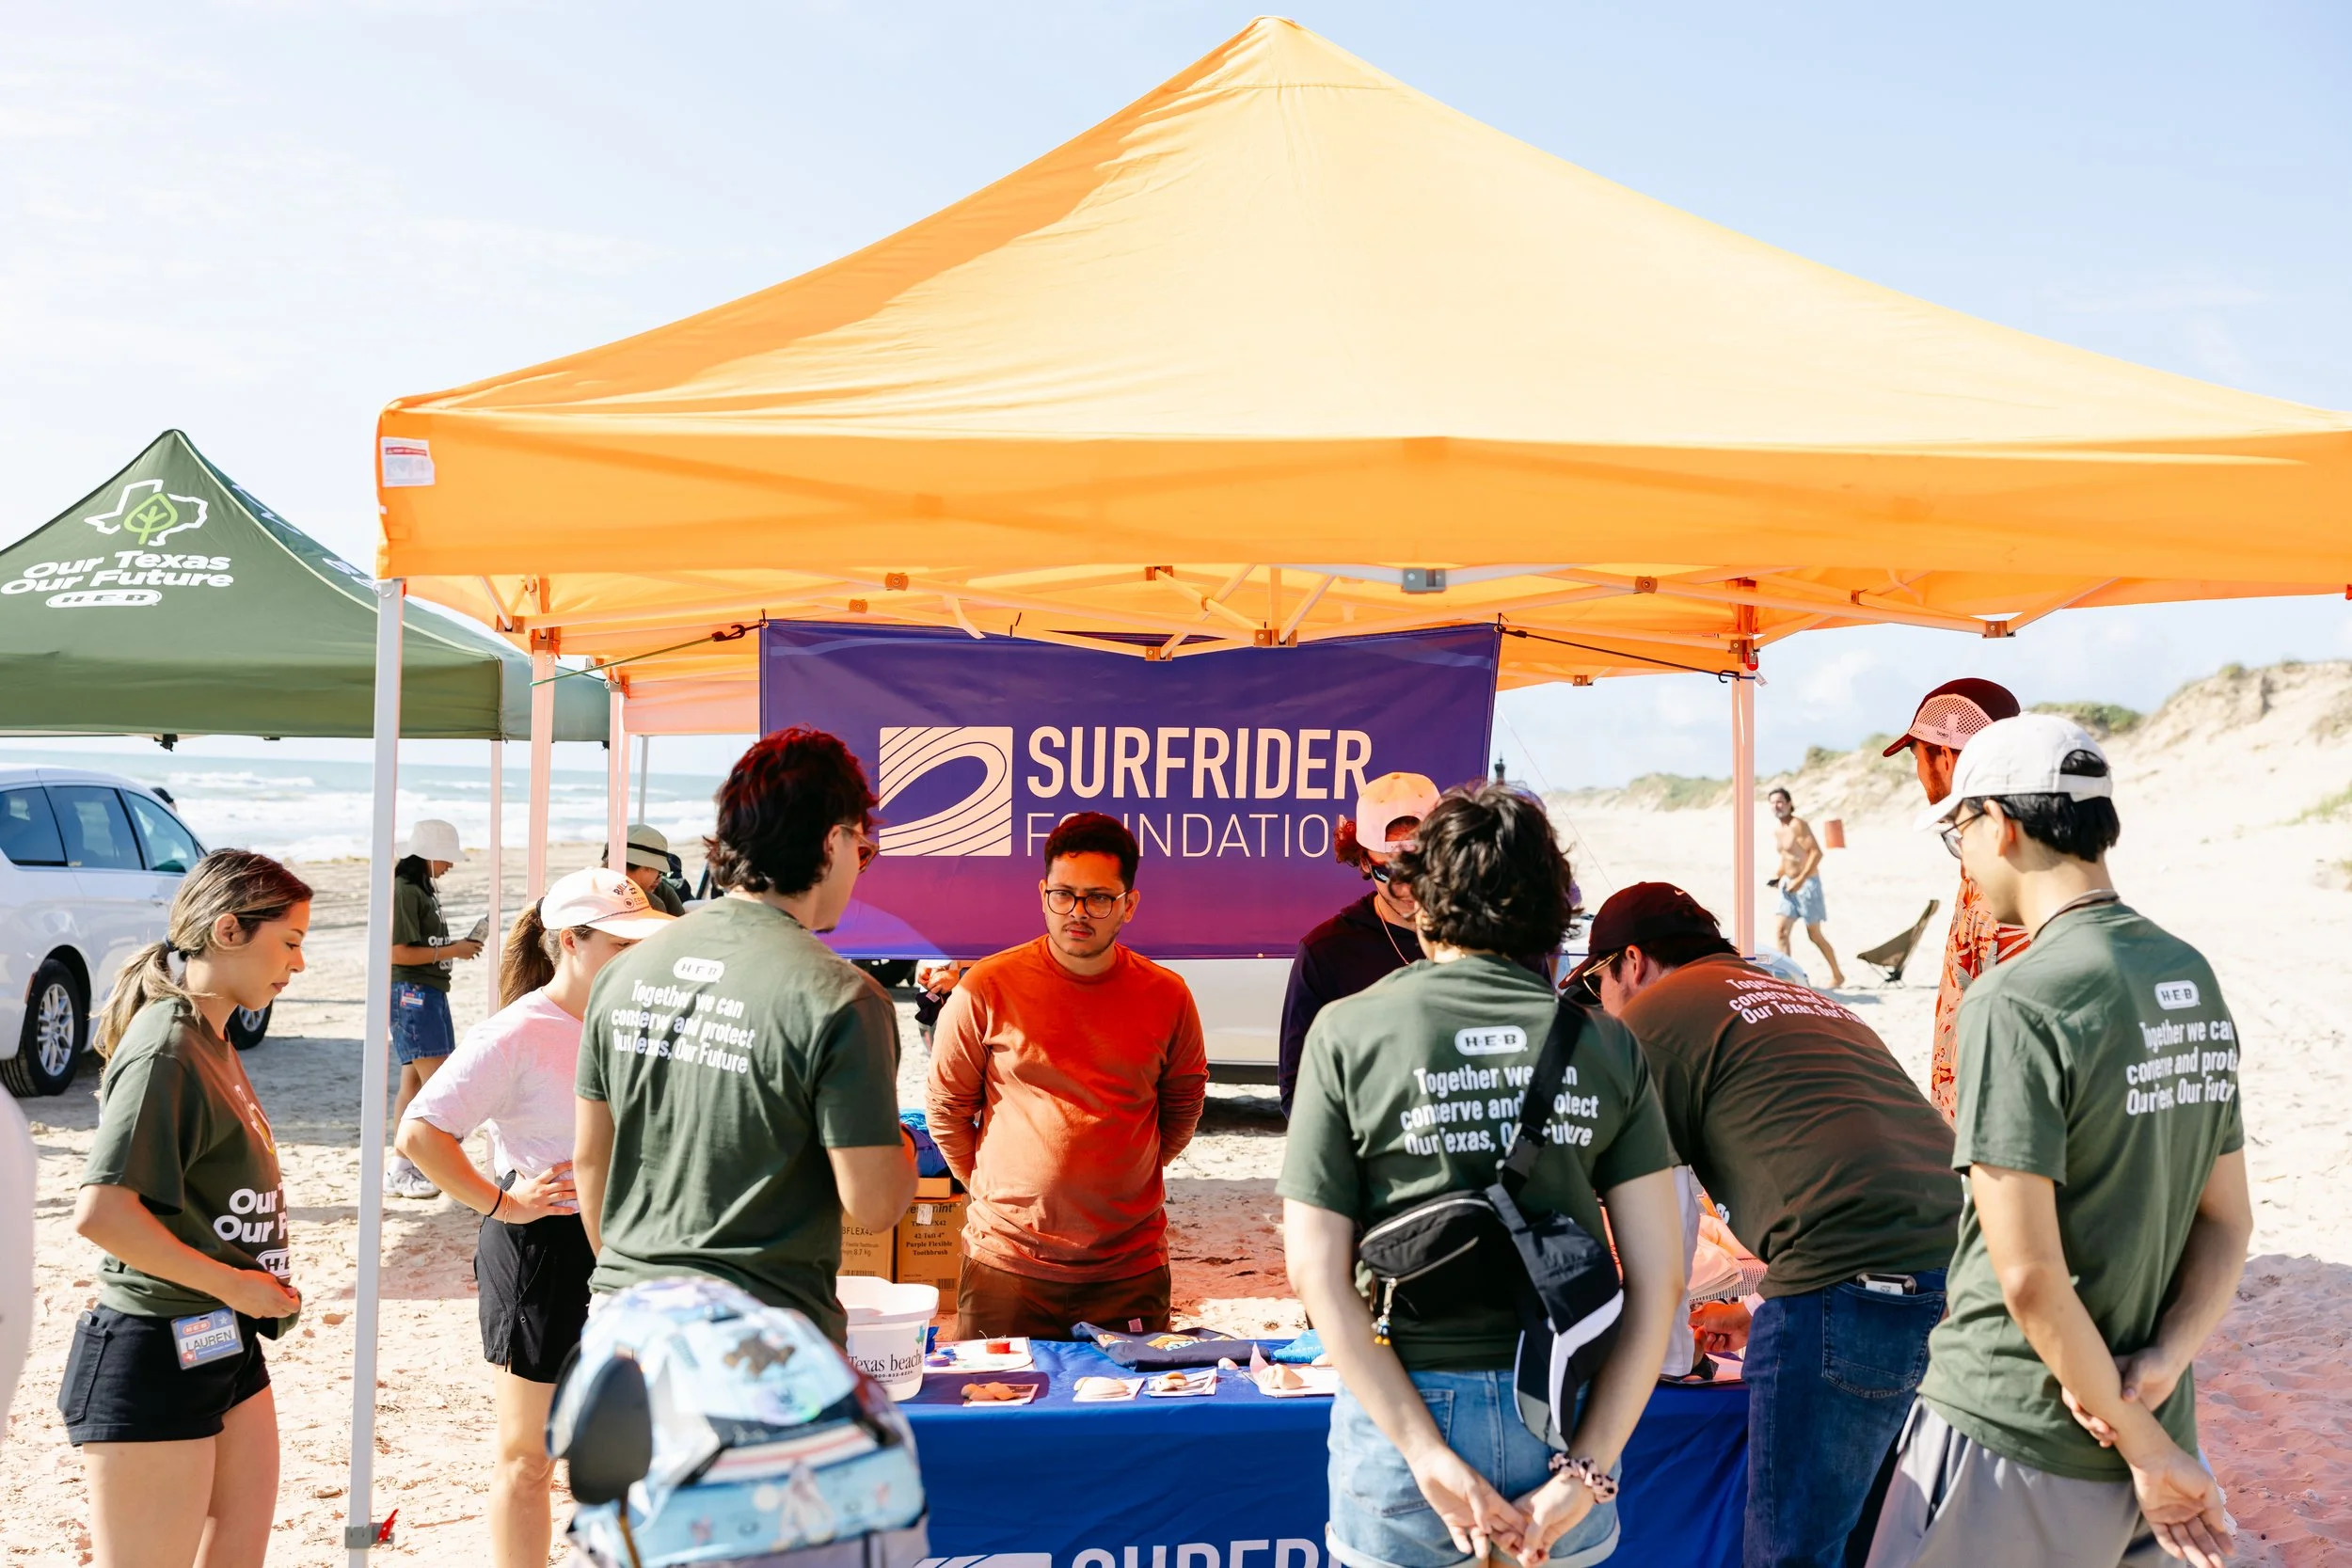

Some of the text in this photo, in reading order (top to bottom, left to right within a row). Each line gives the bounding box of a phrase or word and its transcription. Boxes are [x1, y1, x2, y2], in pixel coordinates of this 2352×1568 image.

[23, 550, 231, 578] Our Texas
[0, 569, 234, 594] Our Future
[1026, 725, 1373, 800] SURFRIDER
[1026, 812, 1347, 858] FNDATIO
[631, 979, 744, 1019] Together we can
[1729, 990, 1797, 1011] conserve
[1740, 1004, 1773, 1024] Our
[674, 1014, 704, 1037] and
[699, 1021, 755, 1049] protect
[2185, 1021, 2206, 1042] we
[675, 1037, 698, 1063] Our
[697, 1042, 749, 1074] Future
[2173, 1045, 2199, 1074] and
[1413, 1063, 1500, 1099] Together
[1502, 1065, 1534, 1087] we
[2176, 1077, 2202, 1105] Our
[1487, 1089, 1525, 1120] and
[1553, 1091, 1599, 1119] otect
[229, 1188, 278, 1214] Our
[213, 1214, 275, 1243] Our
[842, 1226, 873, 1236] BFLEX42
[185, 1329, 232, 1352] LAUREN
[849, 1355, 885, 1372] Texas
